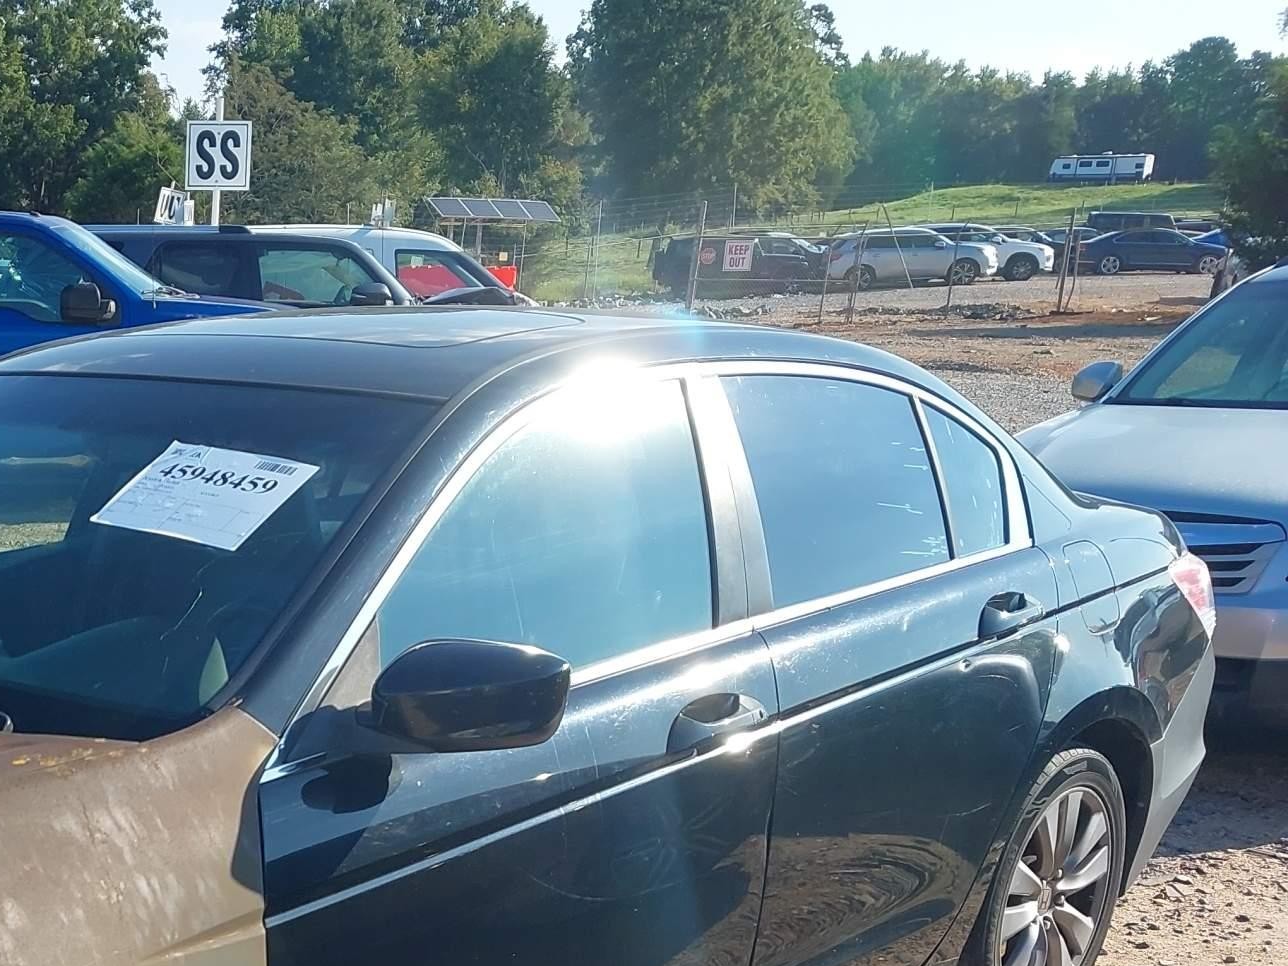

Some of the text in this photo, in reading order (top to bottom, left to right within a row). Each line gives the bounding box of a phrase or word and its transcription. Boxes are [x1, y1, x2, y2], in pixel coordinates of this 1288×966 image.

[195, 129, 241, 180] SS
[728, 244, 750, 256] KEEP
[729, 256, 746, 267] OUT
[160, 463, 279, 494] 45948459
